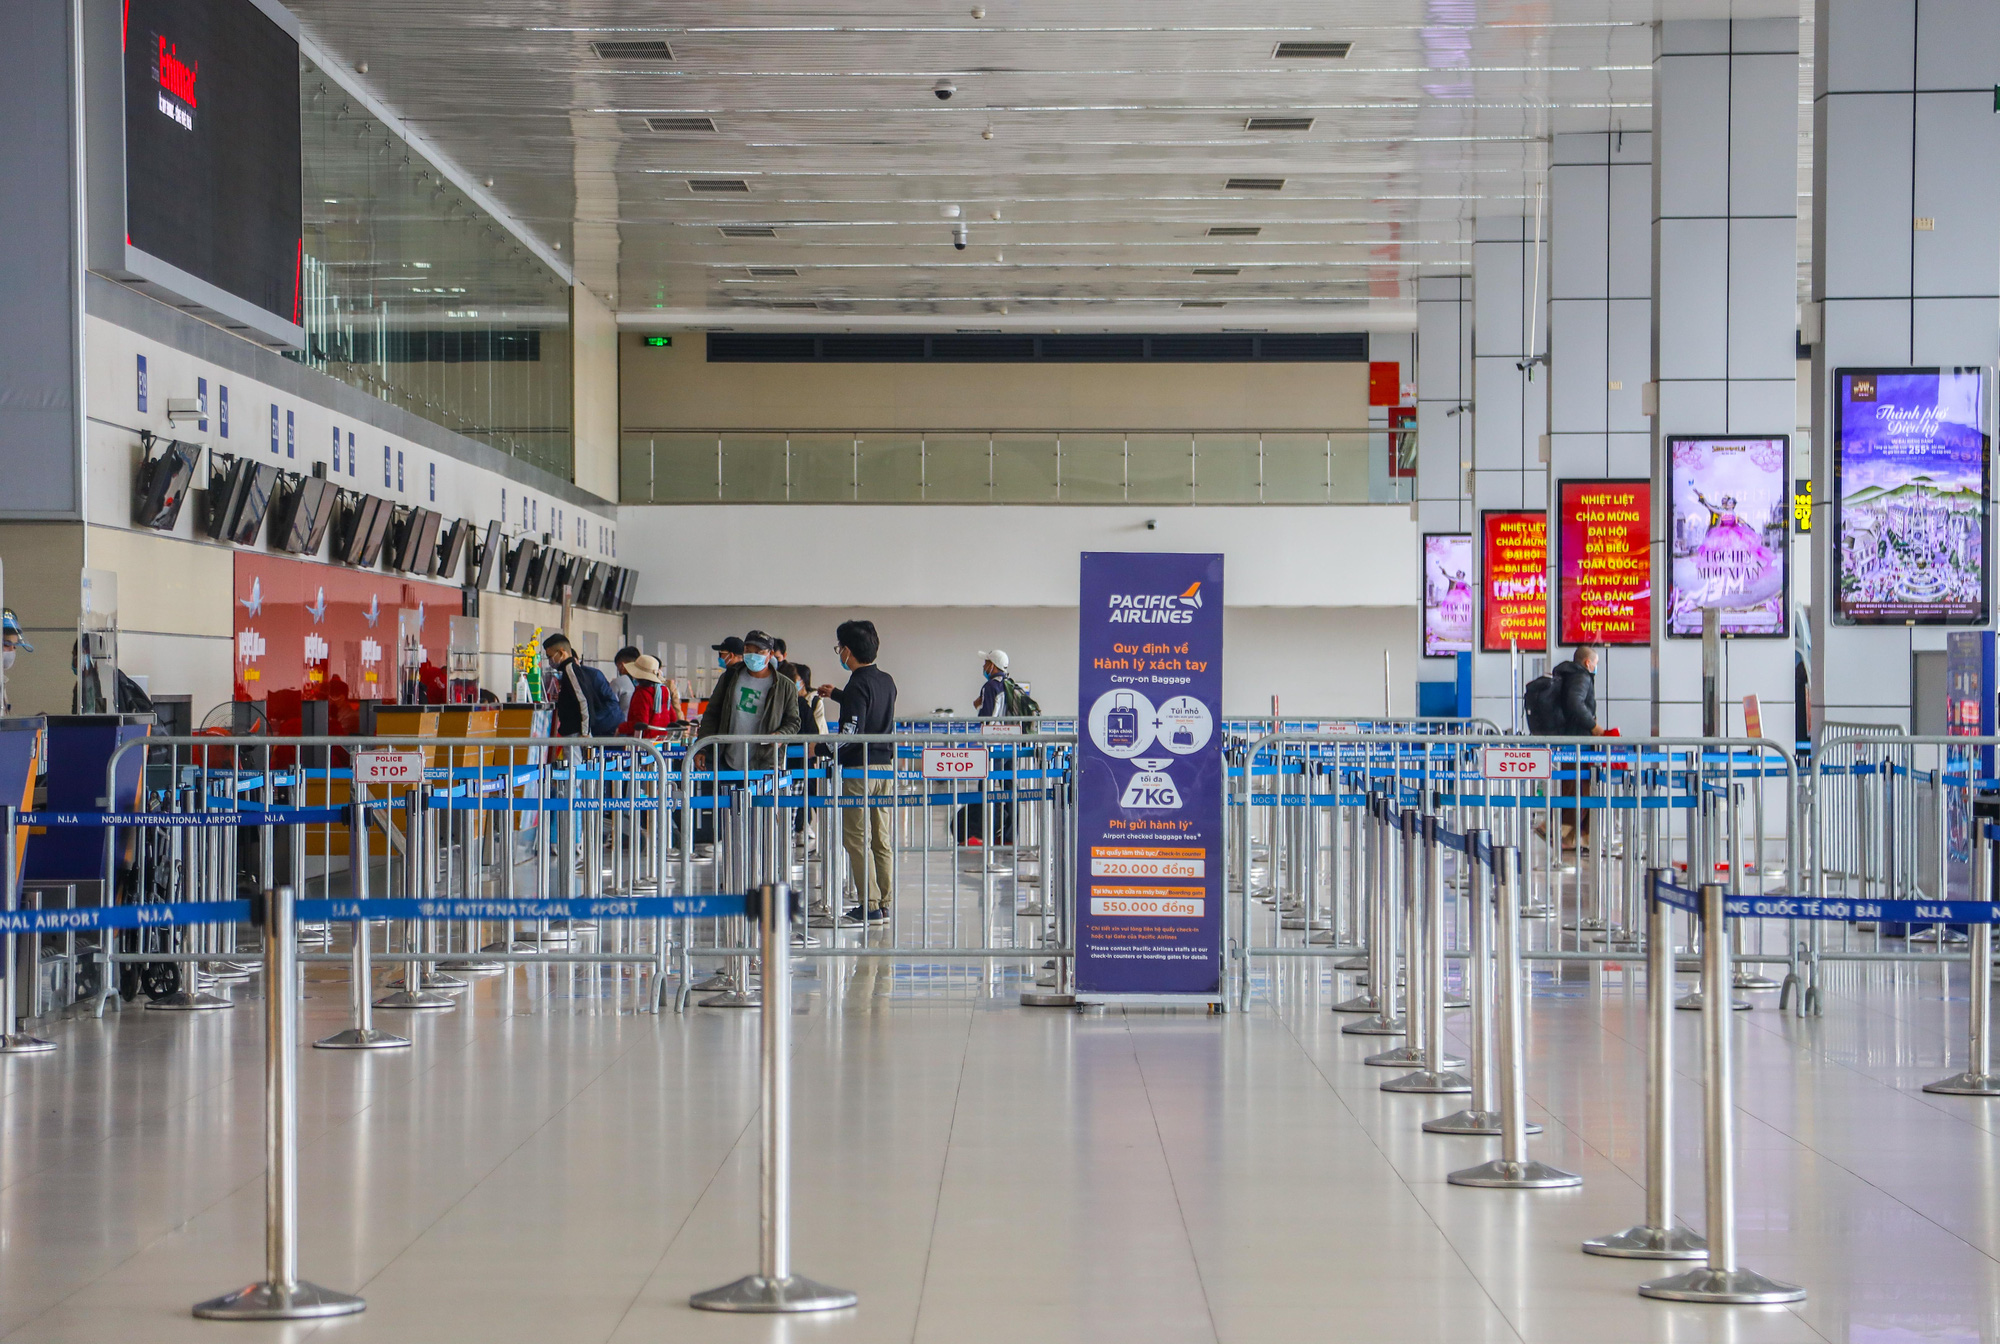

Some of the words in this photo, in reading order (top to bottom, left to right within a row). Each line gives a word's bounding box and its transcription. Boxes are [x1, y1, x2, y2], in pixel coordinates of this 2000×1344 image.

[1581, 494, 1611, 506] NHIỆT
[1614, 494, 1634, 506] LIỆT
[1576, 511, 1605, 522] CHÀO
[1607, 509, 1640, 522] MỪNG
[1500, 522, 1527, 534] NHIỆT
[1587, 526, 1606, 539] ĐẠI
[1608, 525, 1627, 538] HỘI
[1496, 536, 1520, 547] CHÀO
[1585, 543, 1603, 555] ĐẠI
[1606, 542, 1629, 553] BIỂU
[1506, 550, 1525, 561] ĐẠI
[1504, 564, 1521, 574] ĐẠI
[1577, 558, 1606, 569] TOÀN
[1608, 558, 1638, 570] QUỐC
[1576, 575, 1597, 585] LẦN
[1622, 576, 1639, 585] XIII
[1581, 590, 1602, 601] CỦA
[1604, 589, 1634, 601] ĐẢNG
[1109, 594, 1178, 609] PACIFIC
[1500, 604, 1518, 614] CỦA
[1520, 604, 1546, 614] ĐẢNG
[1581, 605, 1611, 618] CỘNG
[1109, 609, 1194, 623] AIRLINES
[1500, 618, 1526, 629] CỘNG
[1580, 620, 1602, 633] VIỆT
[1605, 621, 1629, 631] NAM
[1521, 632, 1541, 640] NAM
[1113, 643, 1139, 655] Quy
[1142, 643, 1170, 656] định
[1094, 657, 1129, 669] Hành
[1133, 658, 1145, 671] lý
[1149, 658, 1181, 670] xách
[1185, 659, 1208, 672] tay
[1110, 674, 1149, 684] Carry-on
[1151, 675, 1191, 684] Baggage
[1181, 698, 1186, 708] 1
[1117, 718, 1123, 729] 1
[370, 766, 408, 776] STOP
[936, 762, 974, 772] STOP
[1499, 762, 1537, 772] STOP
[1131, 788, 1175, 805] 7KG
[574, 800, 587, 809] AN
[57, 814, 79, 823] N.I.A
[134, 815, 202, 825] INTERNATIONAL
[205, 814, 242, 824] AIRPORT
[264, 814, 286, 822] N.I.A
[1109, 819, 1126, 829] Phí
[1129, 819, 1147, 830] gửi
[1150, 820, 1176, 829] hành
[1103, 864, 1158, 874] 220.000
[1162, 863, 1195, 876] đồng
[1103, 902, 1158, 912] 550.000
[1162, 901, 1195, 914] đồng
[1755, 899, 1798, 916] QUỐC
[1802, 899, 1821, 916] TẾ
[1822, 900, 1850, 919] NỘI
[1854, 900, 1882, 918] BÀI
[1915, 904, 1953, 919] N.I.A
[36, 911, 100, 928] AIRPORT
[137, 908, 174, 922] N.I.A
